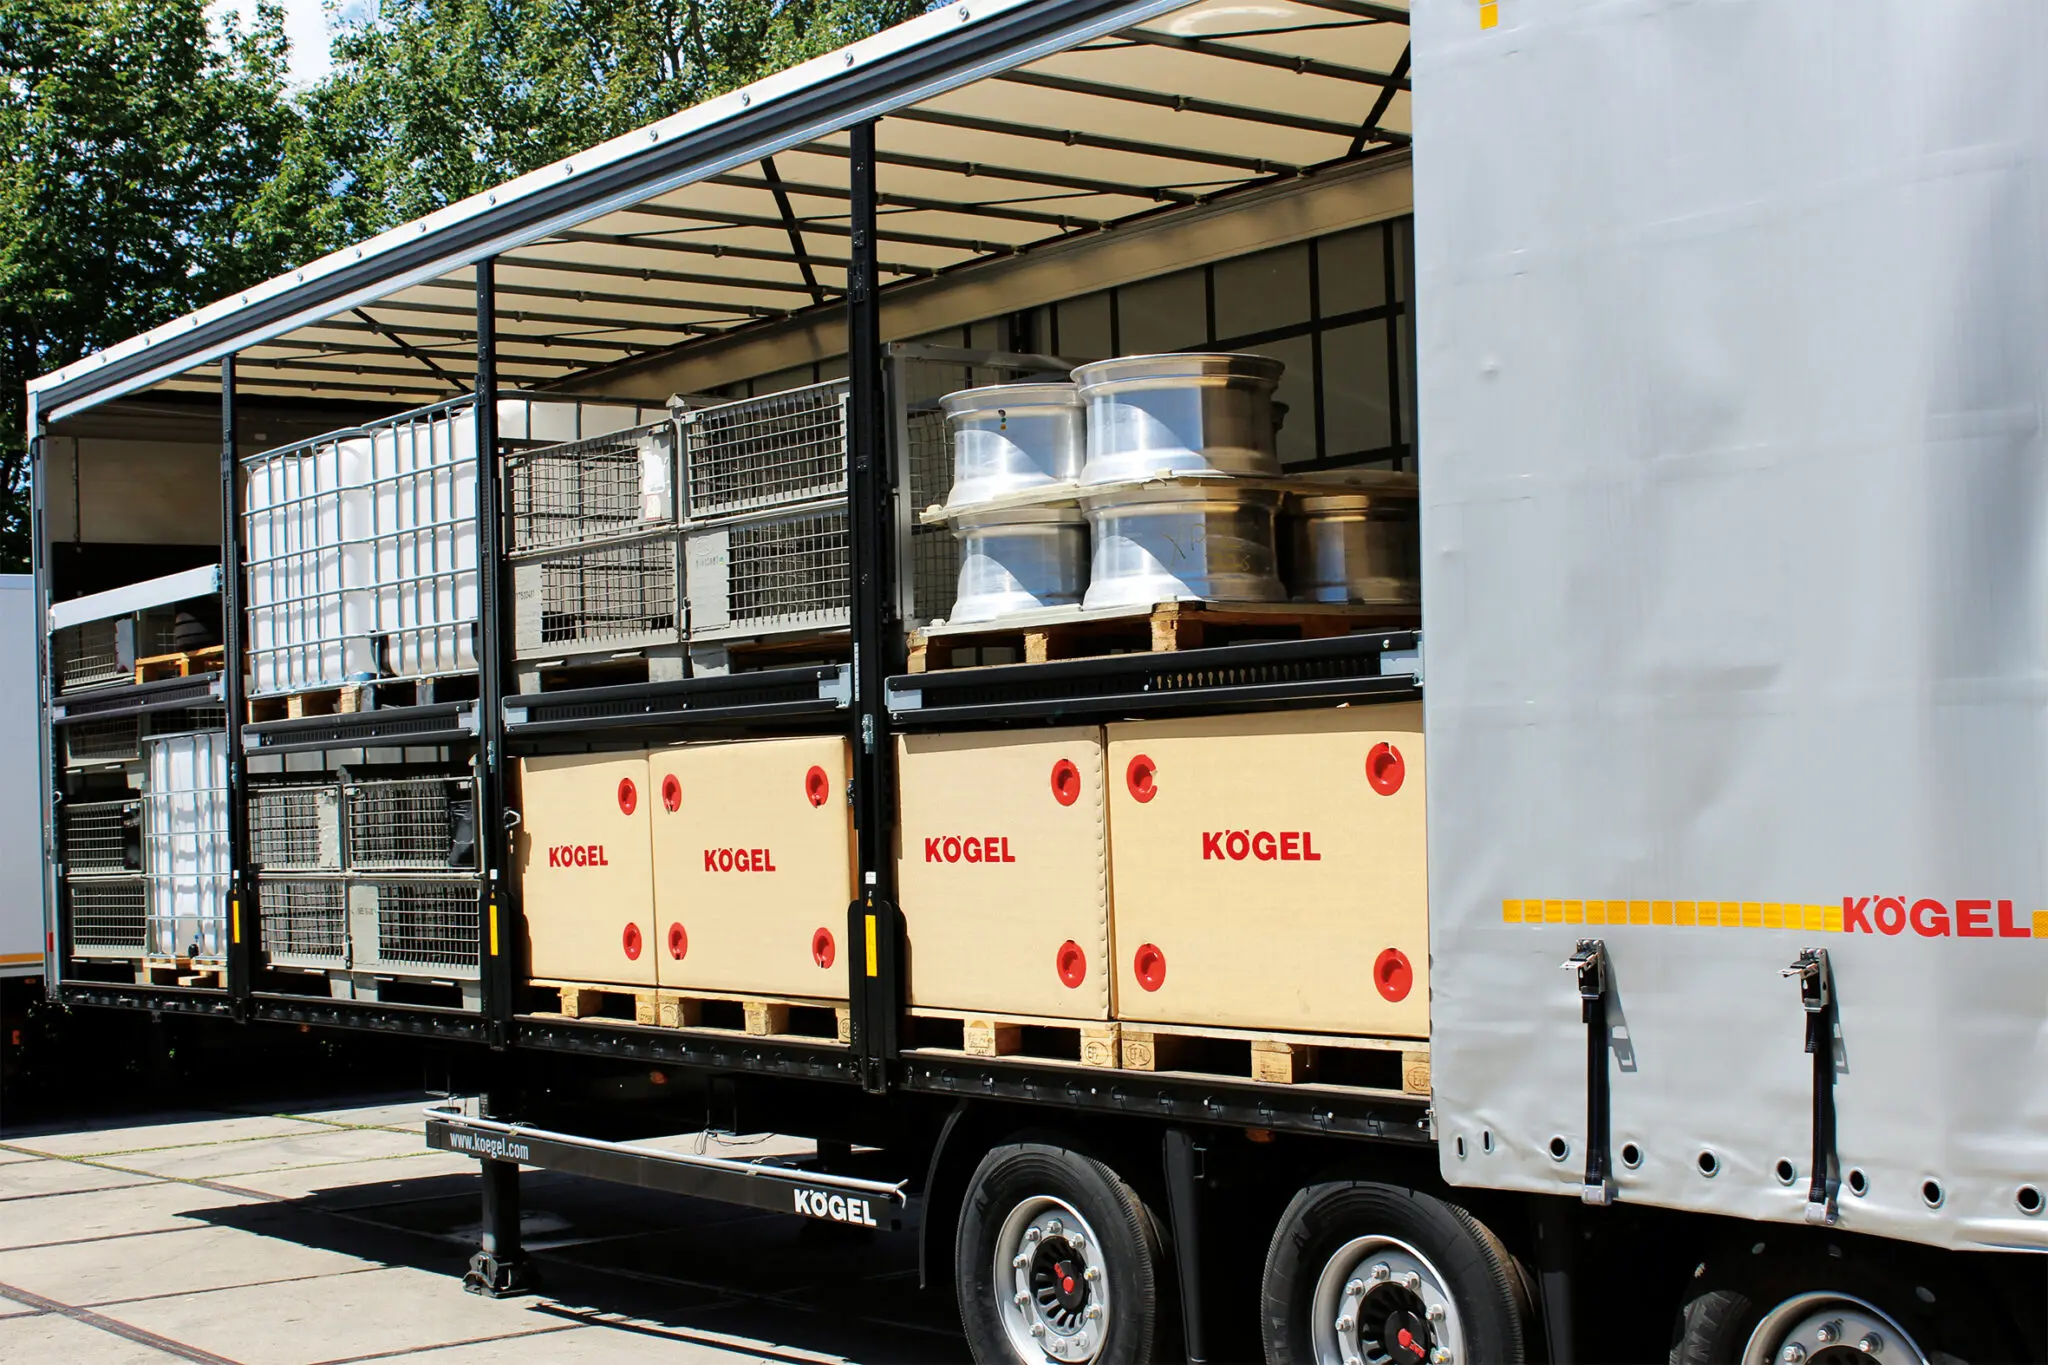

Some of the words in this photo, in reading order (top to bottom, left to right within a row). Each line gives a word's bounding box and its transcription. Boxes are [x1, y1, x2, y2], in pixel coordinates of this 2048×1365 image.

[549, 845, 609, 868] KÖGEL
[925, 836, 1016, 864] KÖGEL
[1202, 829, 1321, 861] KÖGEL
[704, 848, 776, 872] KÖGEL
[1843, 894, 2032, 938] KÖGEL
[449, 1132, 529, 1160] www.koegel.com
[793, 1188, 877, 1227] KÖGEL
